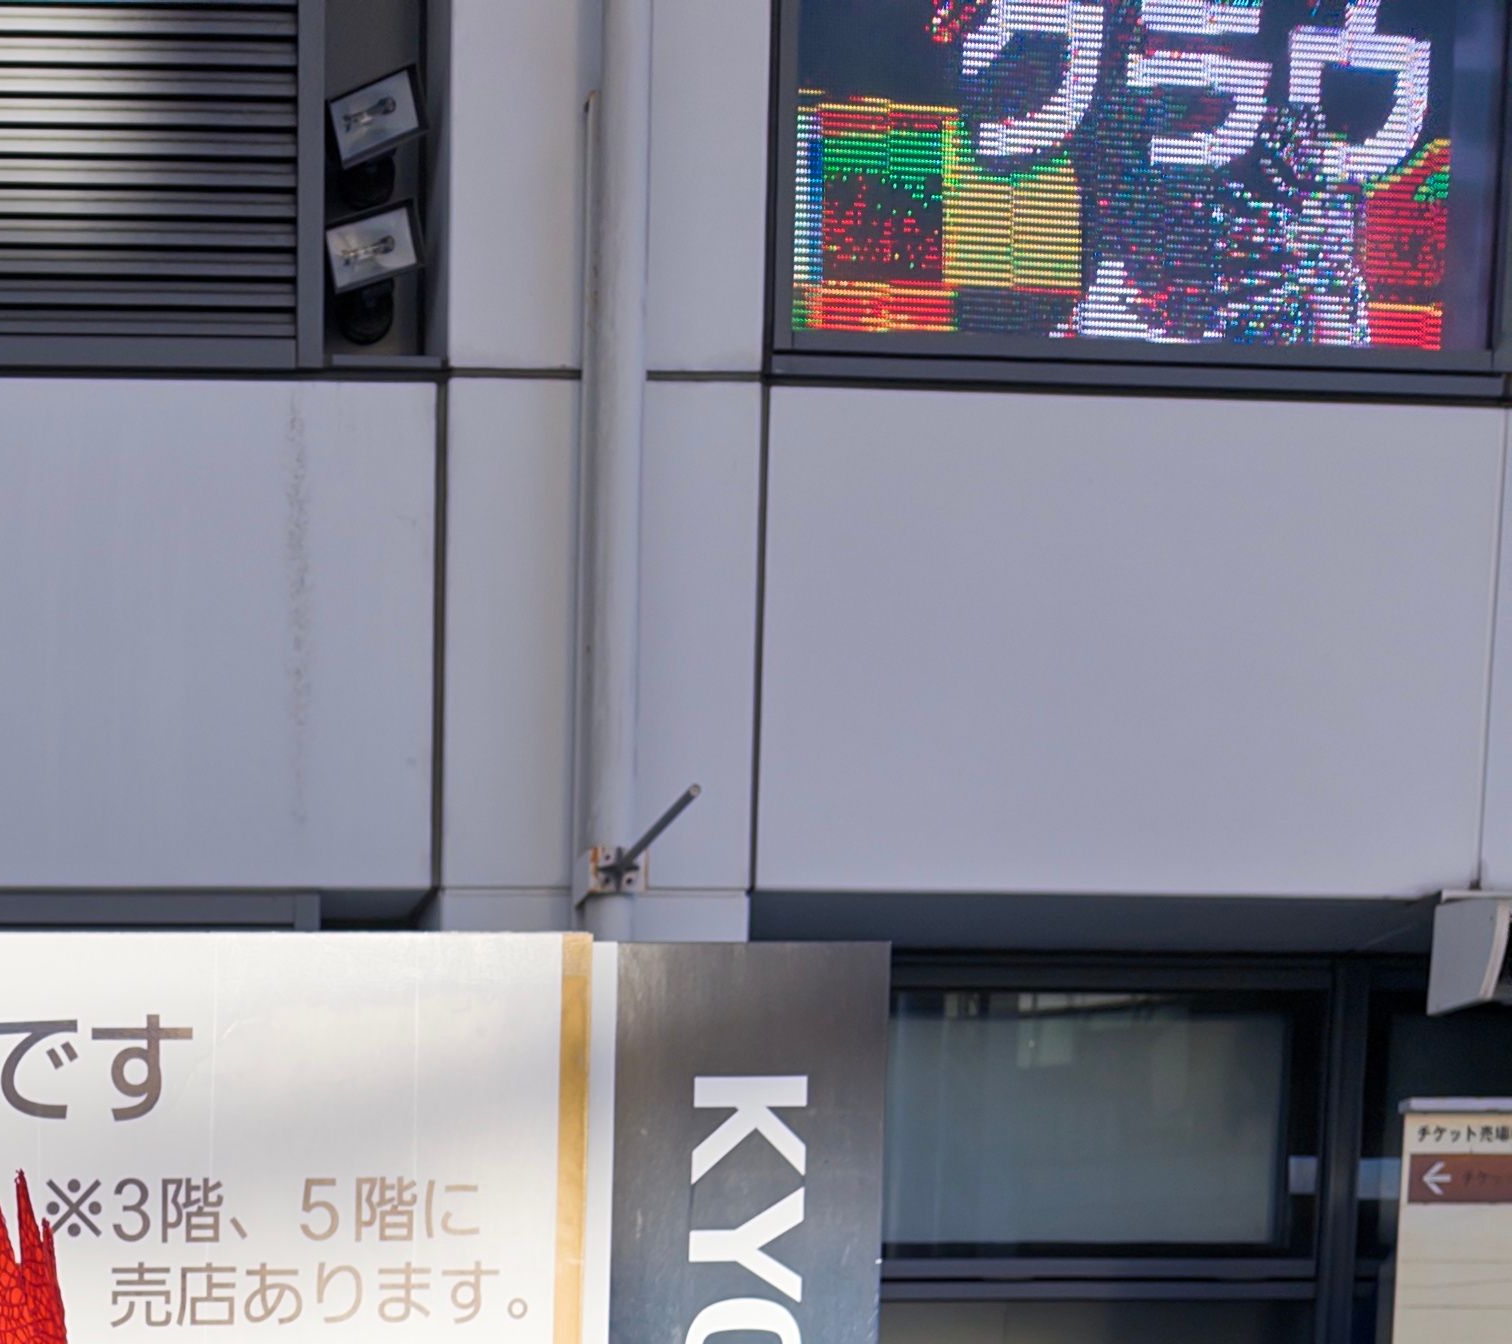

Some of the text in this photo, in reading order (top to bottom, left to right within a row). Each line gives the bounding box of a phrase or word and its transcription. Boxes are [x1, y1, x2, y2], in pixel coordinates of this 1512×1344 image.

[108, 1262, 530, 1328] 売店あります。
